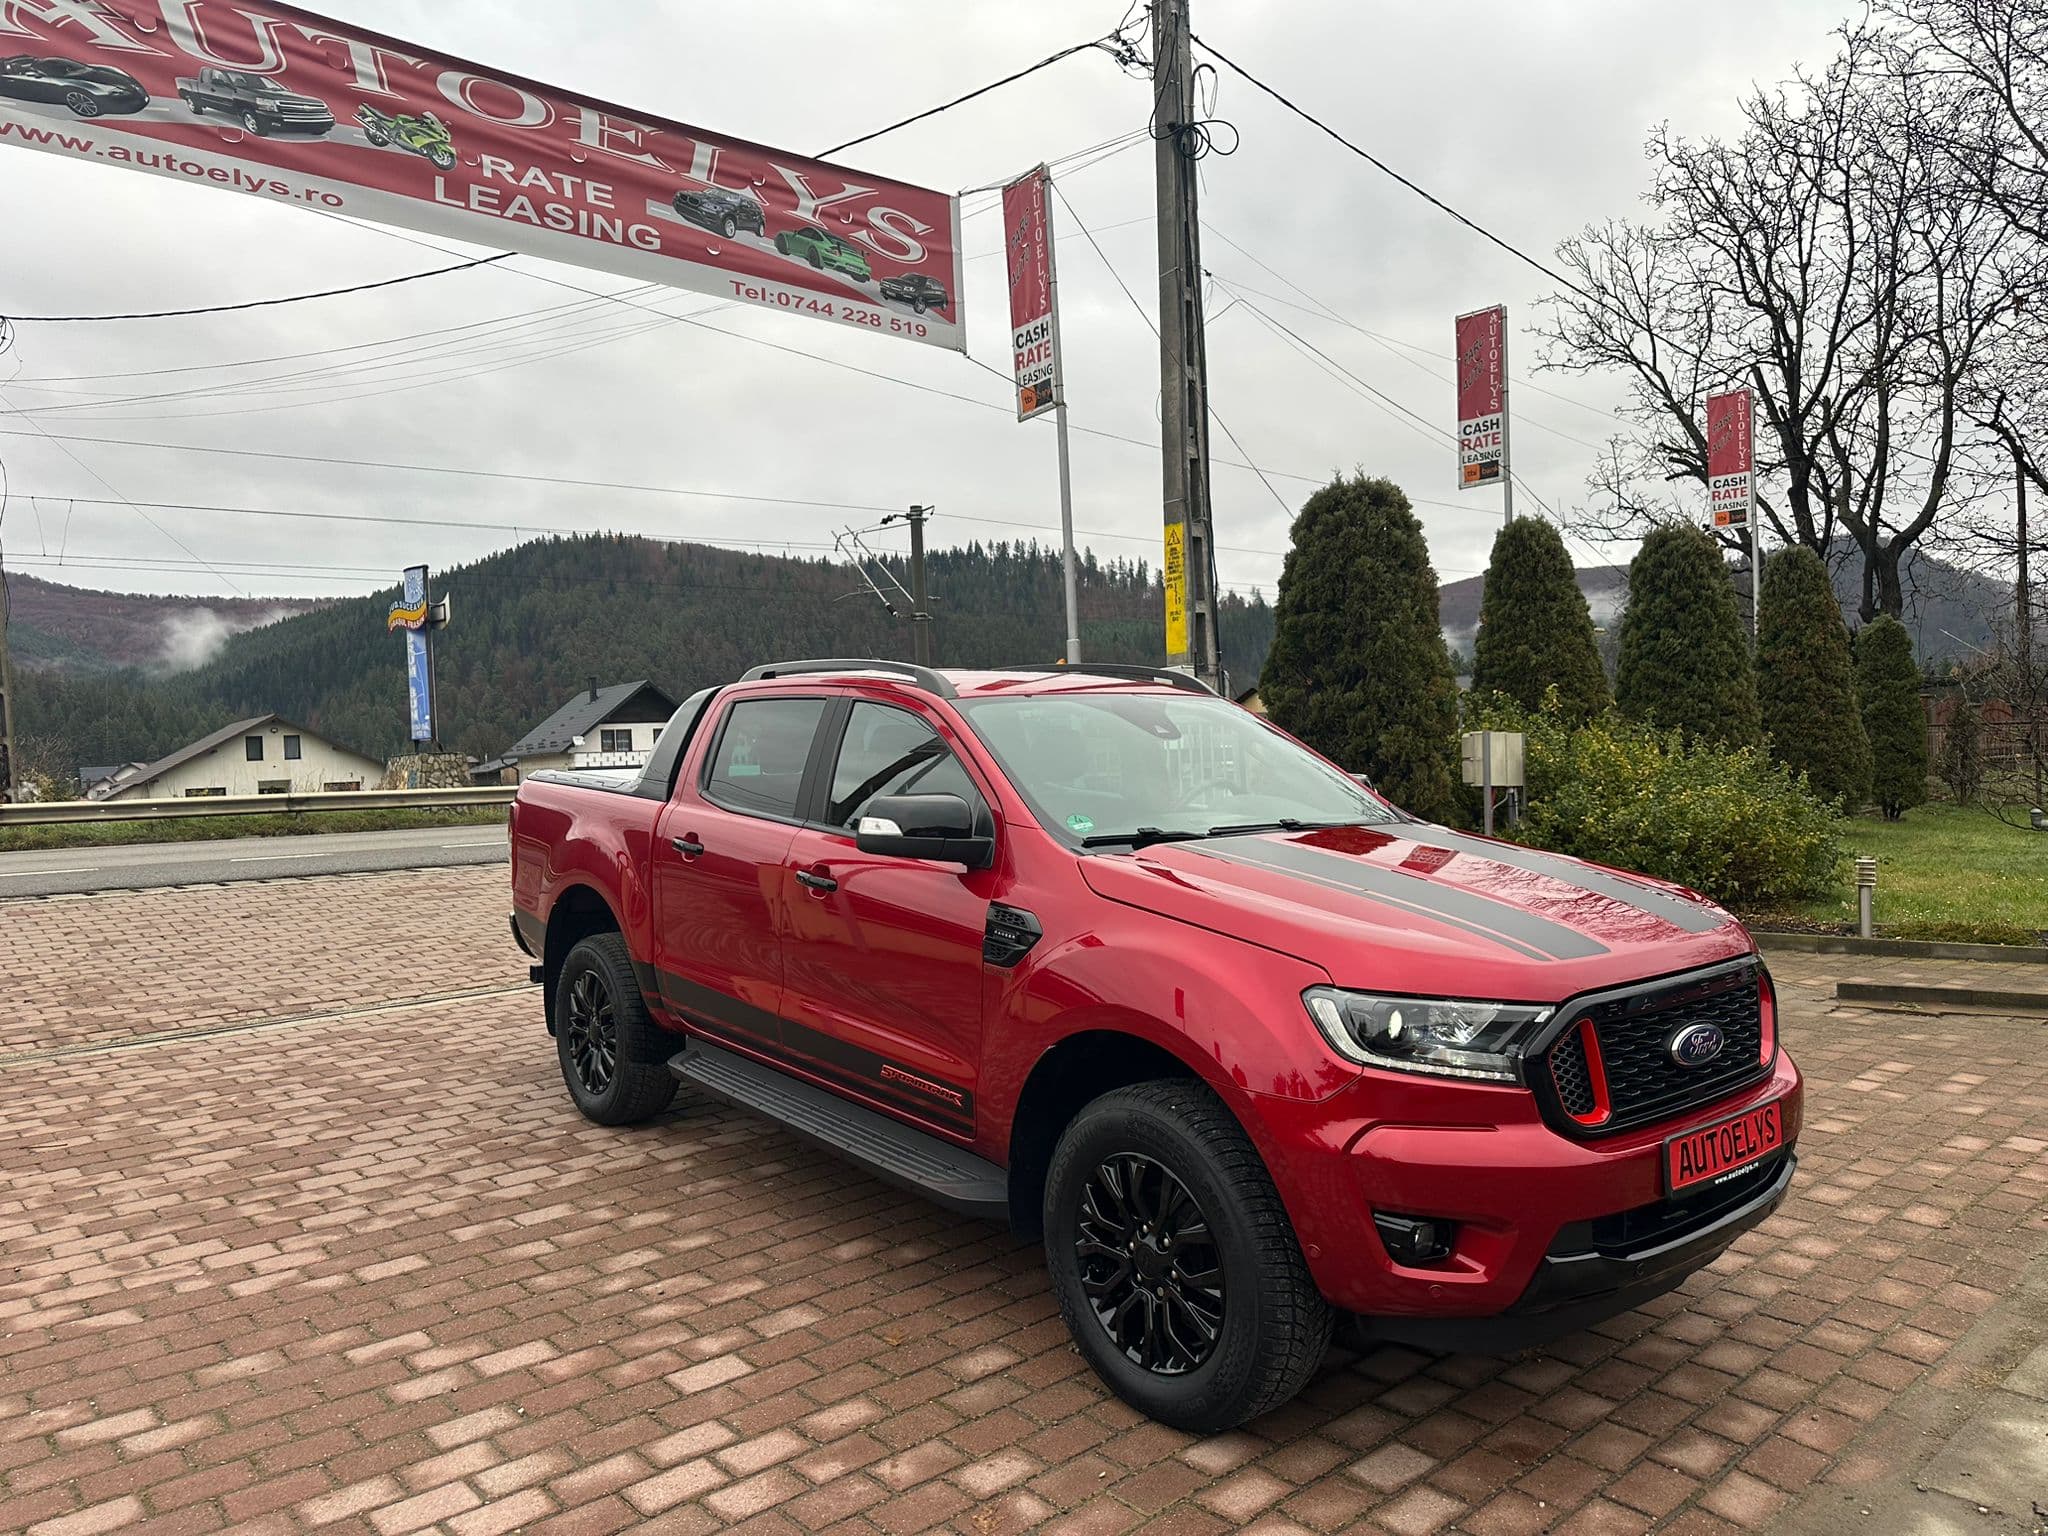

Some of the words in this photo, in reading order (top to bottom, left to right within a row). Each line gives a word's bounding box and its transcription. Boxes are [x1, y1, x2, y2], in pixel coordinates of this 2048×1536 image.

[481, 154, 615, 209] RATE
[435, 176, 661, 250] LEASING
[1033, 176, 1048, 312] AUTOELYS
[729, 280, 834, 316] Tel:0744
[842, 307, 882, 327] 228
[890, 318, 927, 337] 519
[1016, 321, 1049, 348] CASH
[1015, 339, 1052, 370] RATE
[1489, 312, 1499, 410] AUTOELYS
[1019, 363, 1053, 388] LEASING
[1463, 417, 1499, 436] CASH
[1738, 393, 1747, 470] AUTOELYS
[1461, 432, 1501, 452] RATE
[1462, 449, 1501, 464] LEASING
[1712, 486, 1749, 501] RATE
[1713, 475, 1746, 489] CASH
[1713, 500, 1748, 511] LEASING
[1690, 1030, 1717, 1057] Ford
[1679, 1107, 1775, 1181] AUTOELYS
